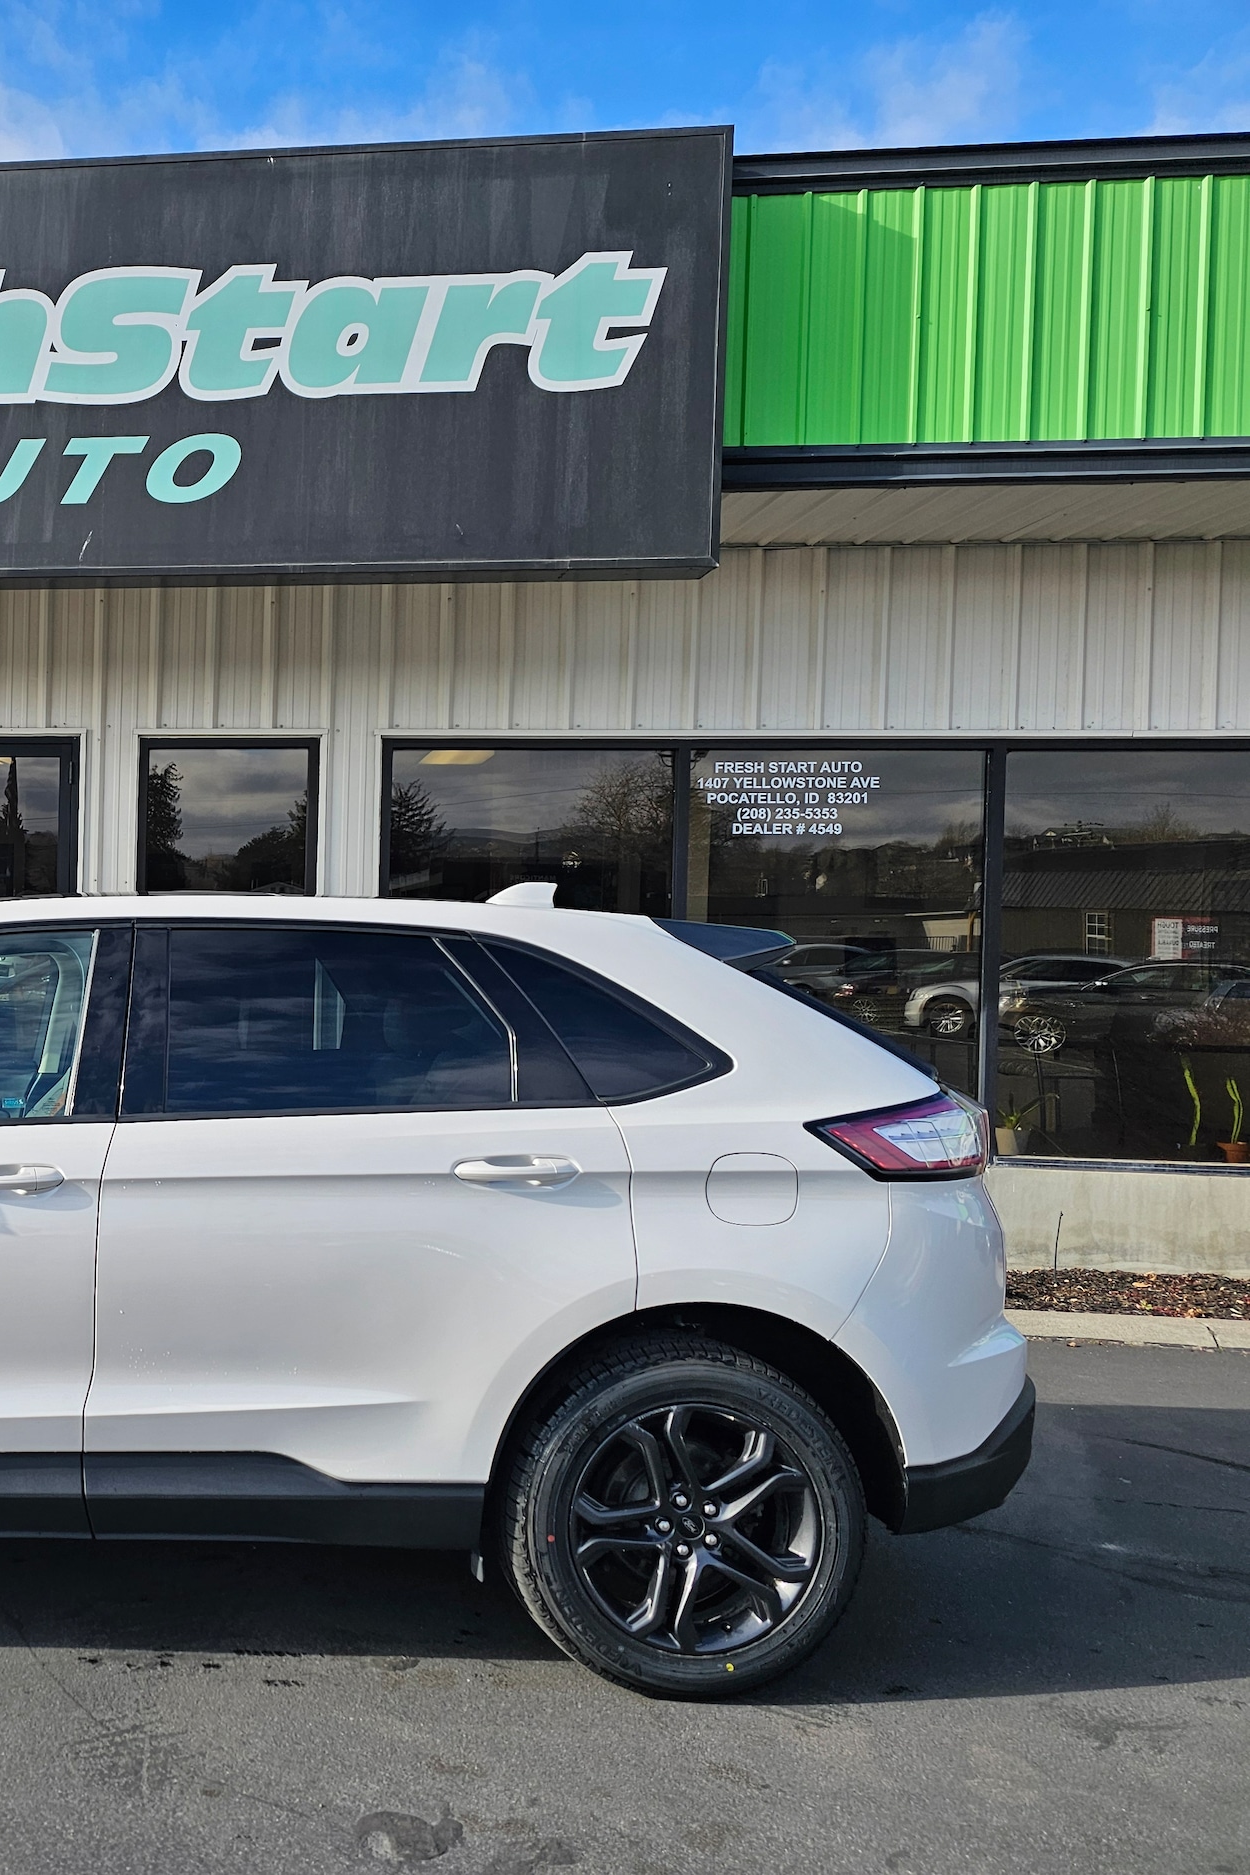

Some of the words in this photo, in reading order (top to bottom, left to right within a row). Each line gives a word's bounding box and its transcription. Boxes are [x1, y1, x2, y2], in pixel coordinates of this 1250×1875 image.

[714, 761, 765, 773] FRESH
[768, 761, 817, 773] START
[822, 761, 863, 773] AUTO
[697, 777, 730, 789] 1407
[733, 777, 847, 789] YELLOWSTONE
[850, 777, 880, 789] AVE
[706, 792, 801, 806] POCATELLO,
[804, 792, 820, 804] ID
[826, 792, 869, 804] 83201
[736, 807, 772, 822] (208)
[775, 807, 838, 819] 235-5353
[732, 823, 793, 835] DEALER
[795, 823, 806, 835] #
[808, 823, 843, 835] 4549
